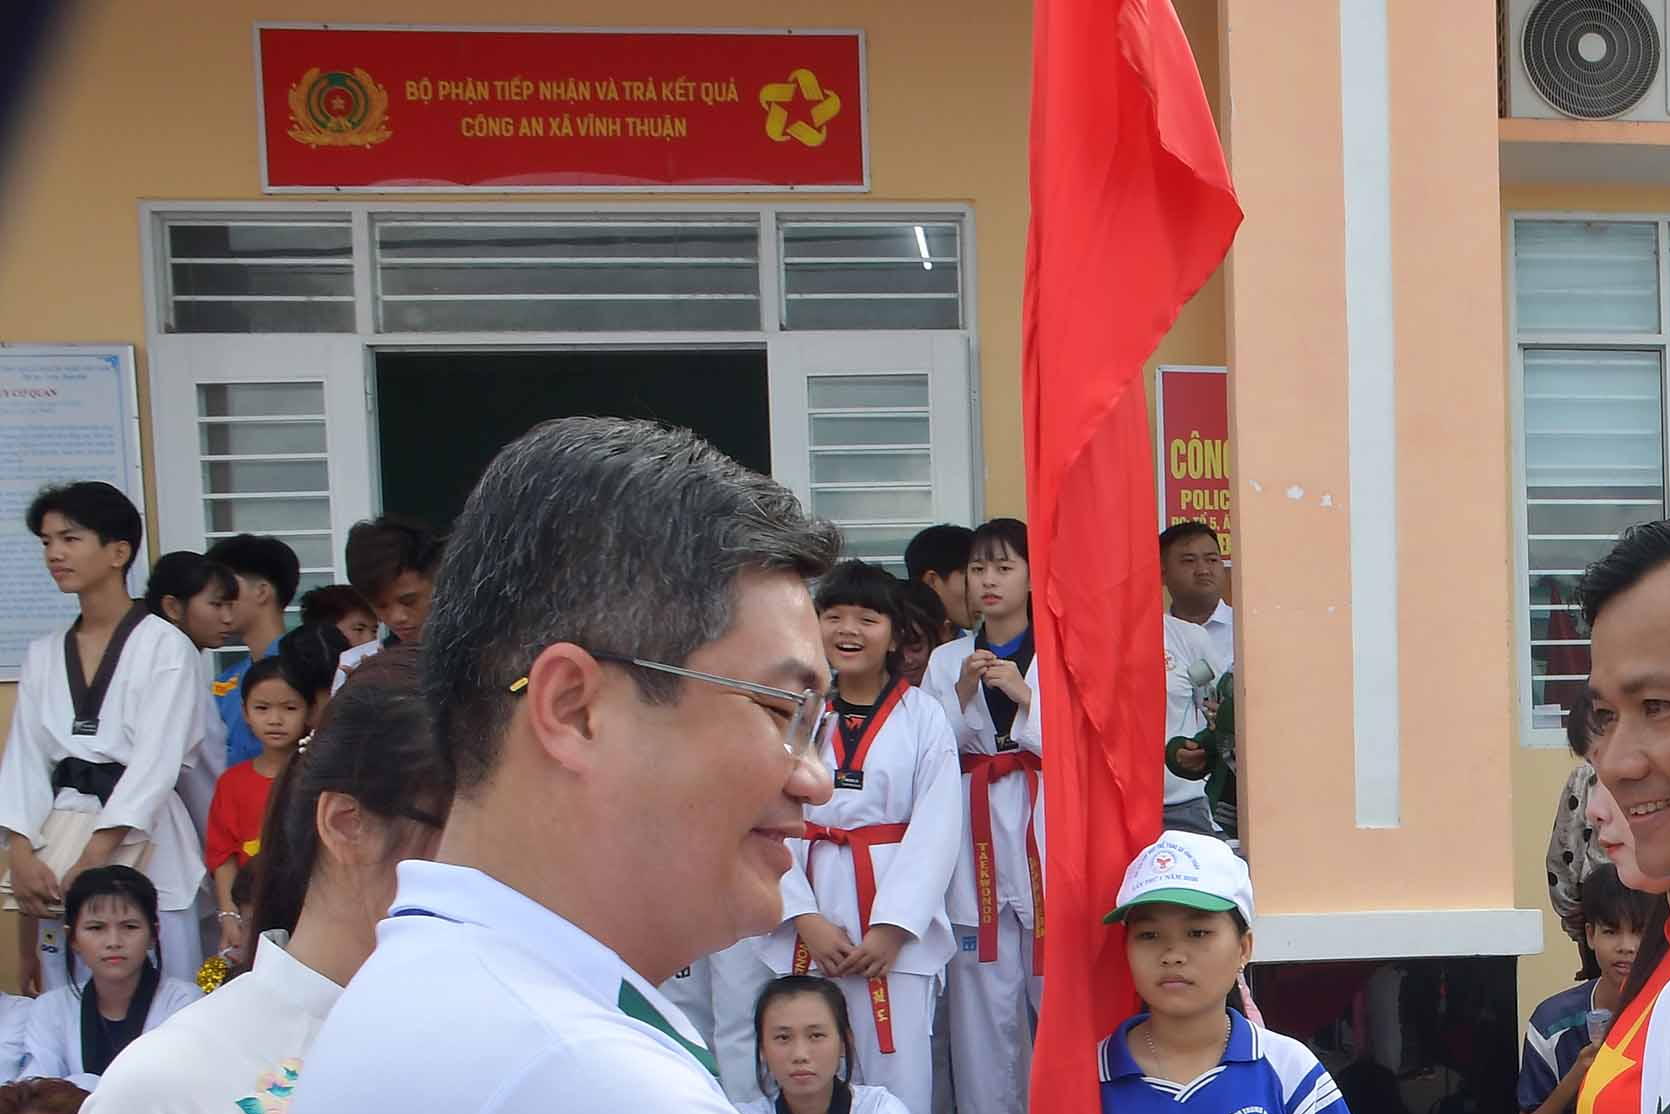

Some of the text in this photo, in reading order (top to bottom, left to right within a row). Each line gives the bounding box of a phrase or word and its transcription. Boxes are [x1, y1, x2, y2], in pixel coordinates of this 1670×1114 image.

[405, 74, 739, 105] BỘ PHẬN TIẾP NHẬN VÀ TRẢ KẾT QUẢ
[461, 112, 688, 142] CÔNG AN XÃ VĨNH THUẬN
[976, 842, 993, 924] TAEKWONDO
